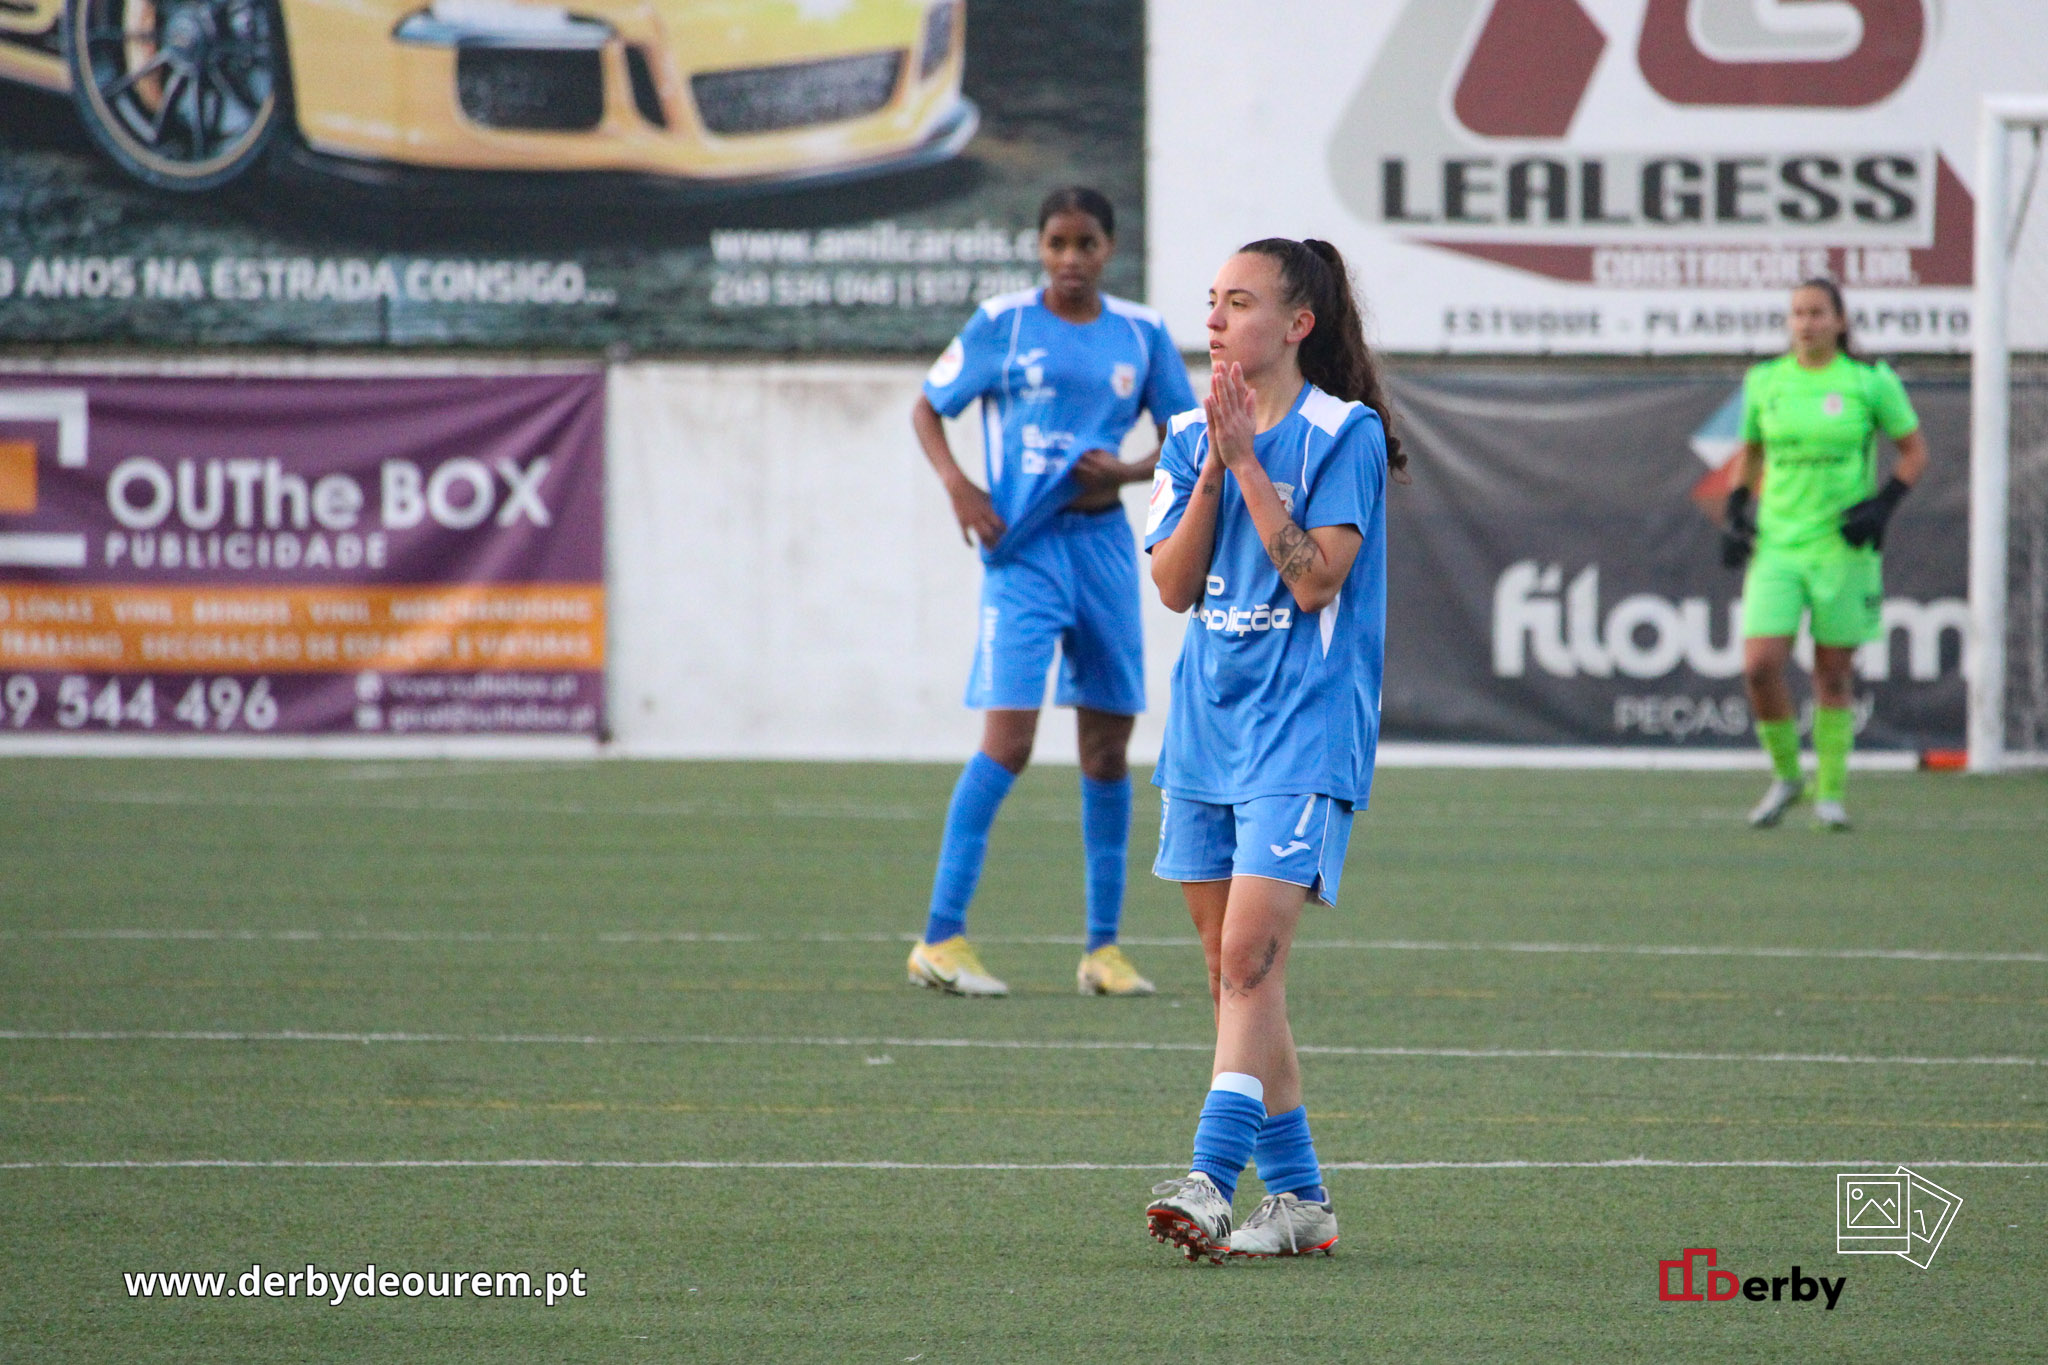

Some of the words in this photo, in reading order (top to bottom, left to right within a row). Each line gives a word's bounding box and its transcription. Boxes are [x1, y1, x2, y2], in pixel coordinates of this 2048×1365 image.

[1382, 156, 1917, 225] LEALGESS
[23, 257, 136, 298] ANOS
[144, 257, 202, 298] NA
[210, 258, 400, 300] ESTRADA
[1850, 310, 1970, 335] APOTO
[381, 457, 551, 530] BOX
[105, 533, 388, 568] PUBLICIDADE
[1492, 560, 1968, 680] filoum
[0, 674, 39, 728] 9
[57, 674, 157, 728] 544
[174, 675, 278, 730] 496
[1613, 694, 1749, 742] PEÇAS
